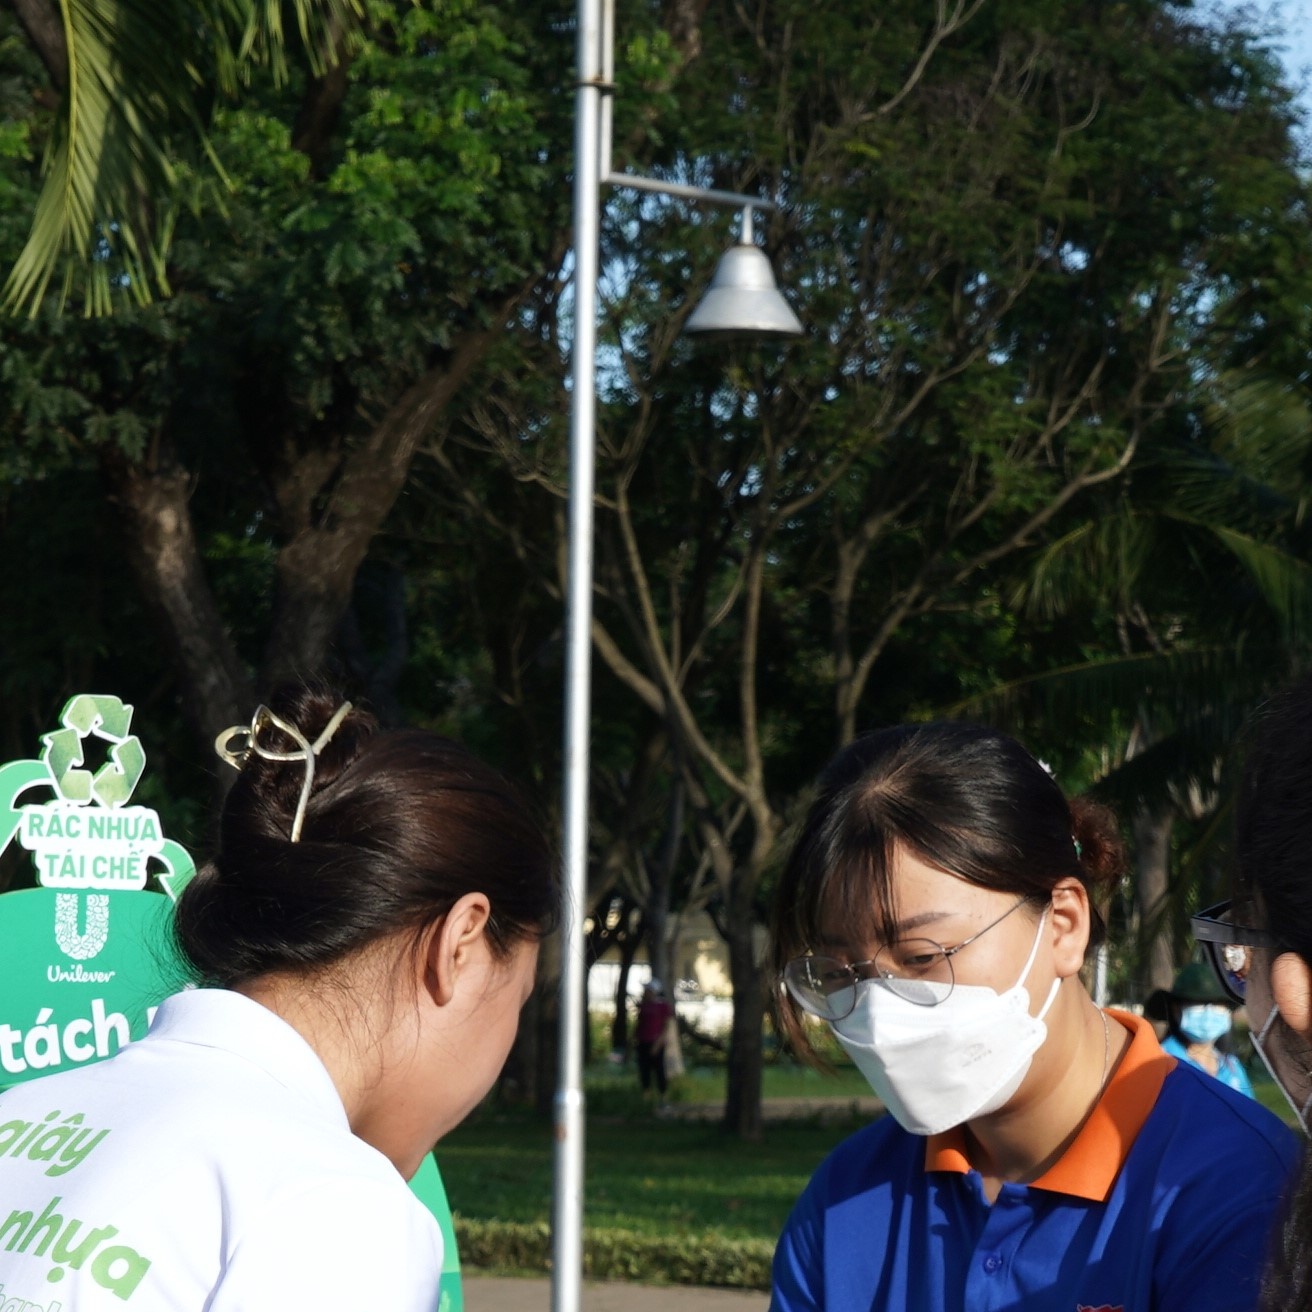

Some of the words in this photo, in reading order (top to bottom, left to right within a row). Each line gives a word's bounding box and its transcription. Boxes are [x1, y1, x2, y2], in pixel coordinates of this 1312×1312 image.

[28, 807, 82, 839] RÁC
[88, 812, 158, 849] NHỰA
[44, 849, 85, 878] TÁI
[92, 849, 144, 881] CHẾ
[47, 964, 116, 983] Unilever
